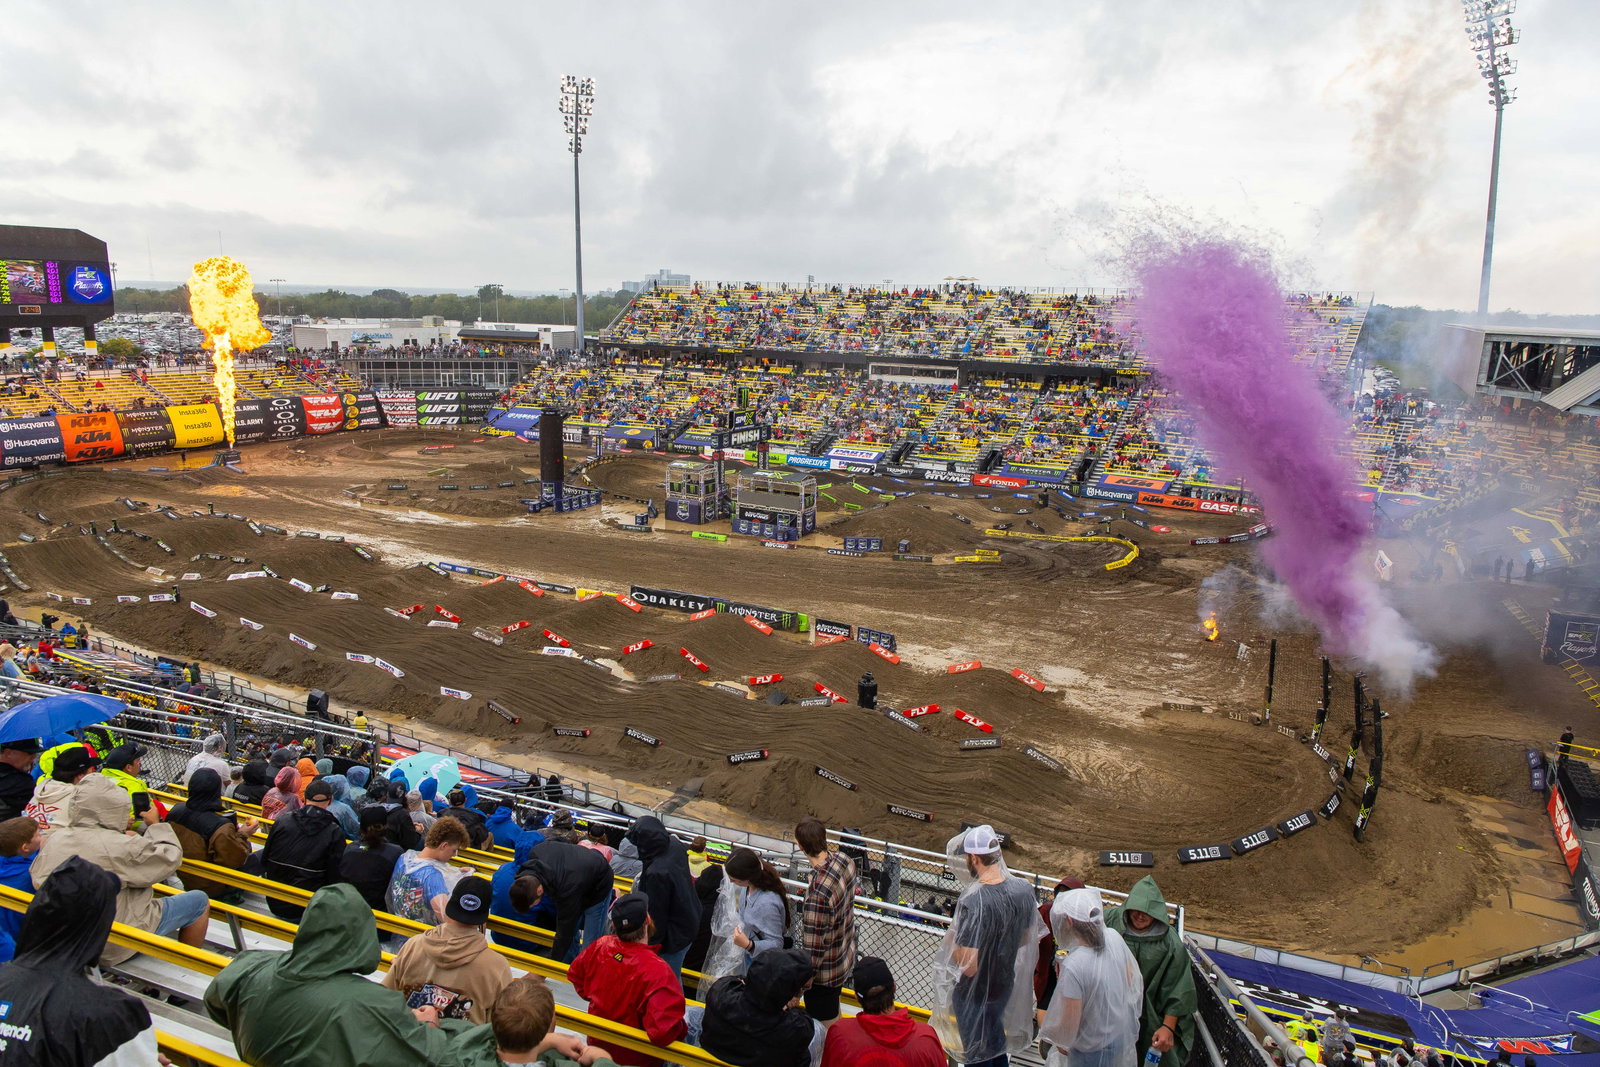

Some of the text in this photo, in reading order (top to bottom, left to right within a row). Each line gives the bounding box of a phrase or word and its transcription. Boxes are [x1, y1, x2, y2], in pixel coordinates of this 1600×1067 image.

[304, 396, 338, 404] FLY
[424, 392, 458, 400] UFO
[179, 408, 208, 416] Insta360
[307, 408, 341, 418] FLY
[425, 404, 460, 412] UFO
[126, 410, 159, 418] MONSTER
[736, 412, 754, 426] SMX
[70, 415, 107, 428] KTM
[425, 416, 460, 424] UFO
[10, 420, 55, 432] Husqvarna
[131, 425, 164, 434] MONSTER
[184, 422, 212, 430] Insta360
[310, 422, 342, 430] FLY
[74, 430, 111, 444] KTM
[186, 436, 214, 444] Insta360
[732, 429, 760, 446] FINISH
[14, 437, 59, 449] Husqvarna
[134, 440, 167, 449] MONSTER
[75, 446, 114, 459] KTM
[788, 456, 828, 467] PROGRESSIVE
[1038, 482, 1070, 490] MONSTER
[1116, 478, 1154, 488] KTM
[1095, 490, 1132, 500] Husqvarna
[1142, 495, 1194, 508] KTM KTM
[432, 567, 447, 577] UFO
[525, 584, 540, 593] FLY
[621, 597, 636, 607] FLY
[649, 595, 704, 610] OAKLEY
[402, 606, 415, 615] FLY
[439, 609, 454, 619] FLY
[696, 611, 709, 619] FLY
[729, 606, 778, 622] MONSTER
[508, 622, 520, 632] FLY
[750, 619, 766, 629] FLY
[293, 636, 308, 646] PARTS
[548, 633, 562, 644] FLY
[629, 642, 644, 652] FLY
[1560, 642, 1597, 654] Playoffs
[876, 647, 894, 658] FLY
[686, 653, 701, 665] FLY
[379, 660, 394, 672] PARTS
[956, 664, 972, 672] FLY
[756, 675, 772, 684] FLY
[1018, 674, 1037, 685] FLY
[444, 688, 462, 696] PARTS
[821, 688, 840, 700] FLY
[911, 706, 929, 716] FLY
[962, 715, 984, 727] FLY
[1312, 743, 1324, 757] 5.11
[1286, 817, 1302, 831] 5.11
[1242, 835, 1260, 849] 5.11
[1109, 853, 1130, 864] 5.11
[1188, 848, 1210, 860] 5.11
[1582, 877, 1600, 920] TRIUMPH
[425, 993, 448, 1007] 1972
